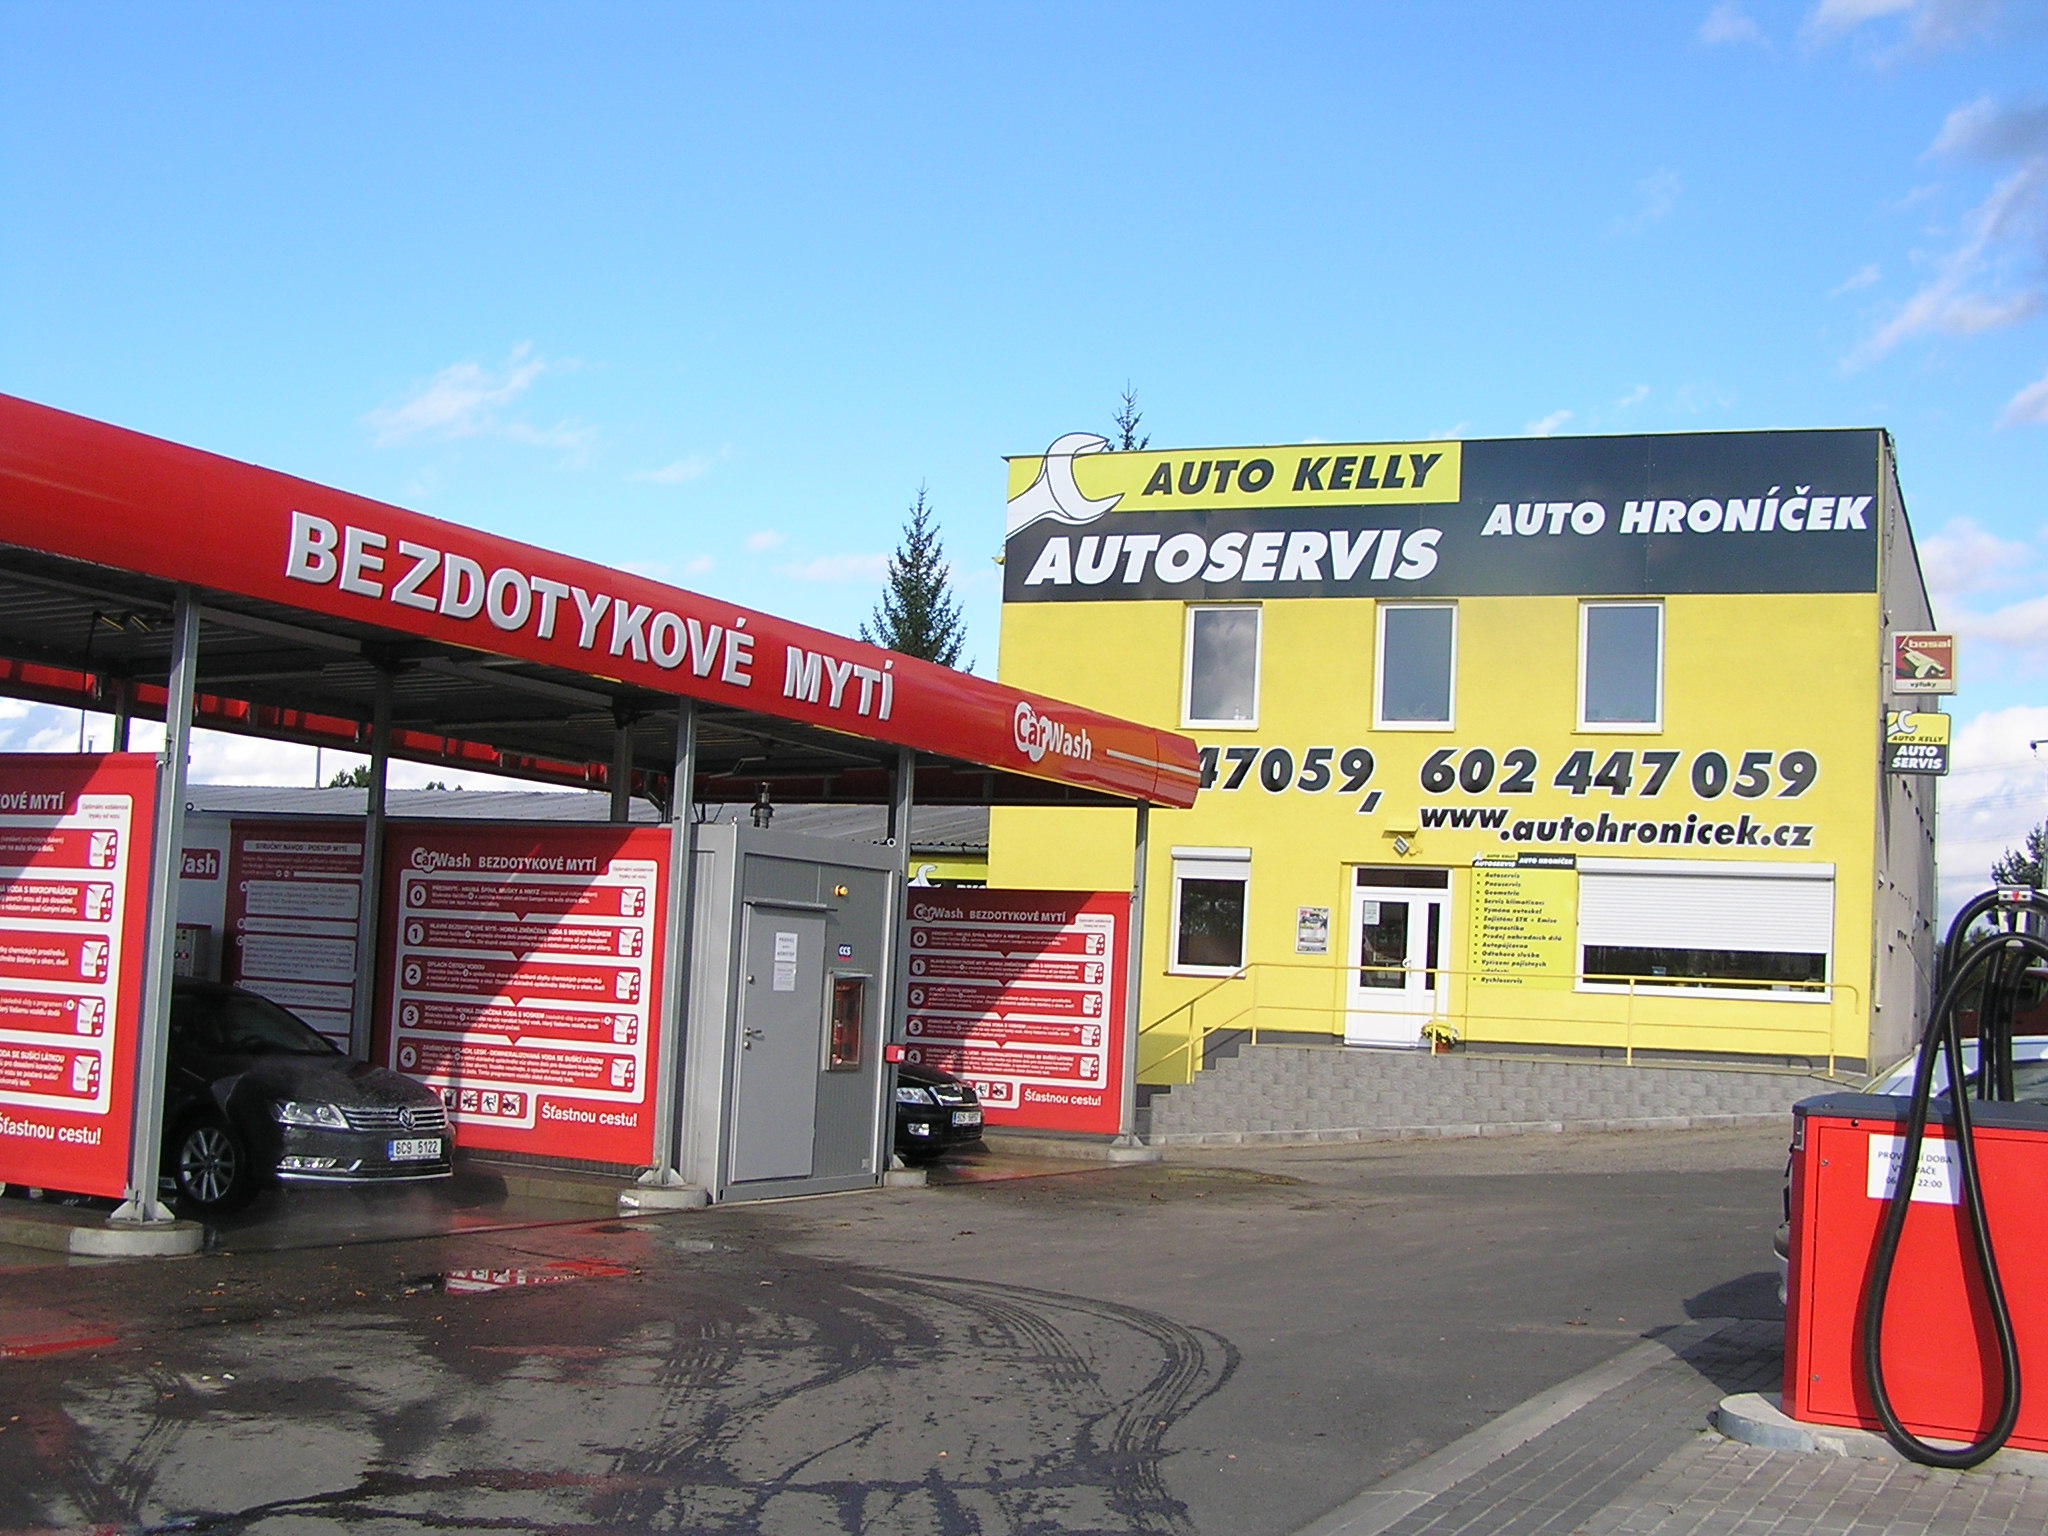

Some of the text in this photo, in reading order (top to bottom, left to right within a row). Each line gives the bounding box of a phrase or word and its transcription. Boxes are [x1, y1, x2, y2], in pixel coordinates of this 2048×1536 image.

[1141, 453, 1443, 496] AUTO KELLY
[1481, 485, 1873, 536] AUTO HRONÍČEK
[1024, 527, 1443, 586] AUTOSERVIS
[285, 510, 894, 721] BEZDOTYKOVÉ MYTÍ
[1908, 639, 1952, 648] bosal
[1014, 701, 1092, 762] CarWash
[1896, 745, 1938, 756] AUTO
[1420, 748, 1537, 794] 602
[1552, 750, 1681, 797] 447
[1691, 749, 1818, 799] 059
[1891, 757, 1942, 769] SERVIS
[0, 791, 65, 810] OVÉ MYTÍ
[1420, 806, 1814, 847] www.autohronicek.cz
[411, 847, 471, 872] CarWash
[478, 855, 564, 870] BEZDOTYKOVÉ
[566, 856, 597, 871] MYTÍ
[913, 903, 1066, 922] CarWash BEZDOTYKOVÉ MYTÍ
[839, 946, 851, 956] CCS
[1024, 1089, 1101, 1106] Šťastnou cestu!
[542, 1101, 638, 1127] Šťastnou cestu!
[58, 1127, 102, 1145] cestu!
[1926, 1154, 1953, 1163] DOBA
